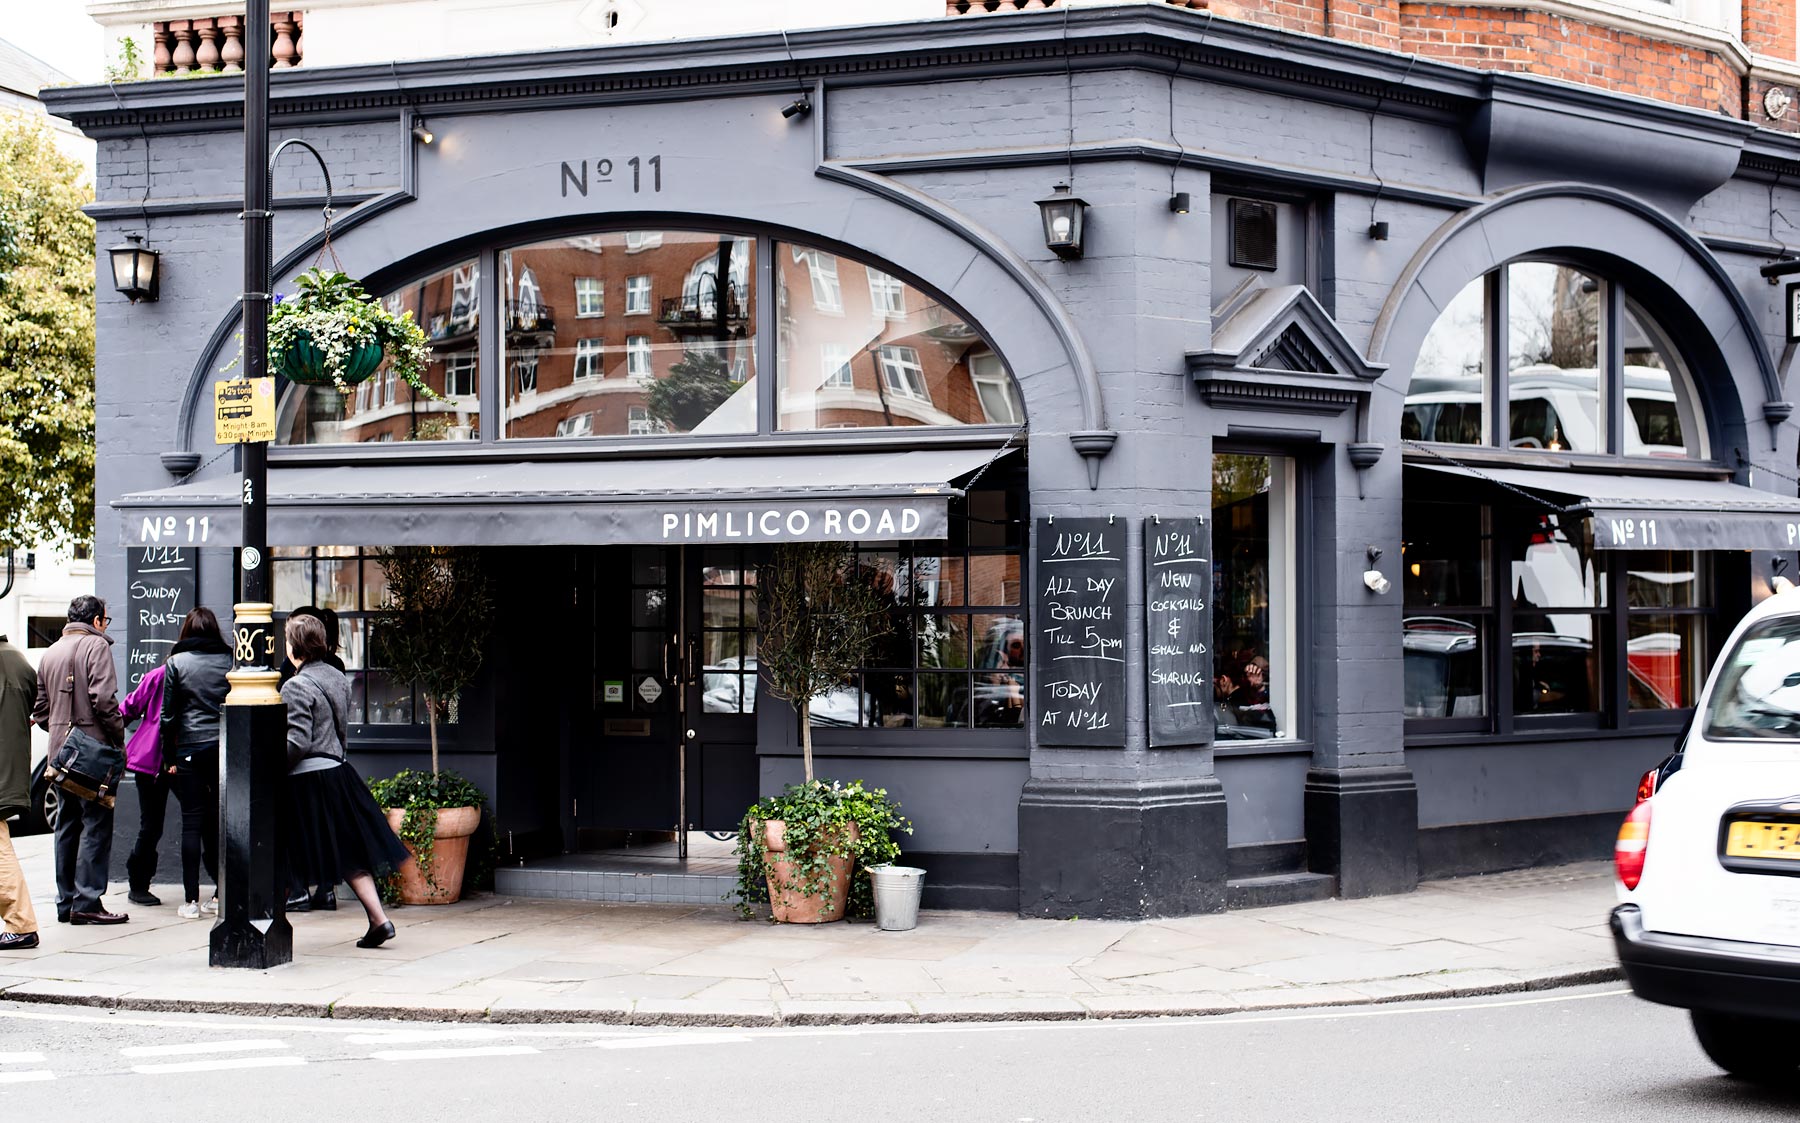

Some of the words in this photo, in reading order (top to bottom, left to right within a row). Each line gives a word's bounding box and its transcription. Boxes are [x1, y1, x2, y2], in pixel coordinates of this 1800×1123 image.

[627, 155, 661, 193] 11
[185, 516, 209, 543] 11
[663, 510, 810, 538] PIMLICO
[824, 508, 921, 534] ROAD
[1640, 519, 1657, 545] 11
[1044, 575, 1077, 597] ALL
[1087, 577, 1115, 603] DAY
[1161, 570, 1192, 588] NEW
[130, 580, 181, 612] SUNDAY
[1151, 598, 1205, 612] COCKTAILS
[139, 609, 187, 626] ROAST
[1048, 601, 1112, 620] BRUNCH
[1081, 625, 1123, 658] 5pm
[1151, 644, 1184, 655] SMALL
[1151, 668, 1205, 686] SHARING
[1044, 680, 1103, 705] TODAY
[1042, 710, 1061, 726] AT
